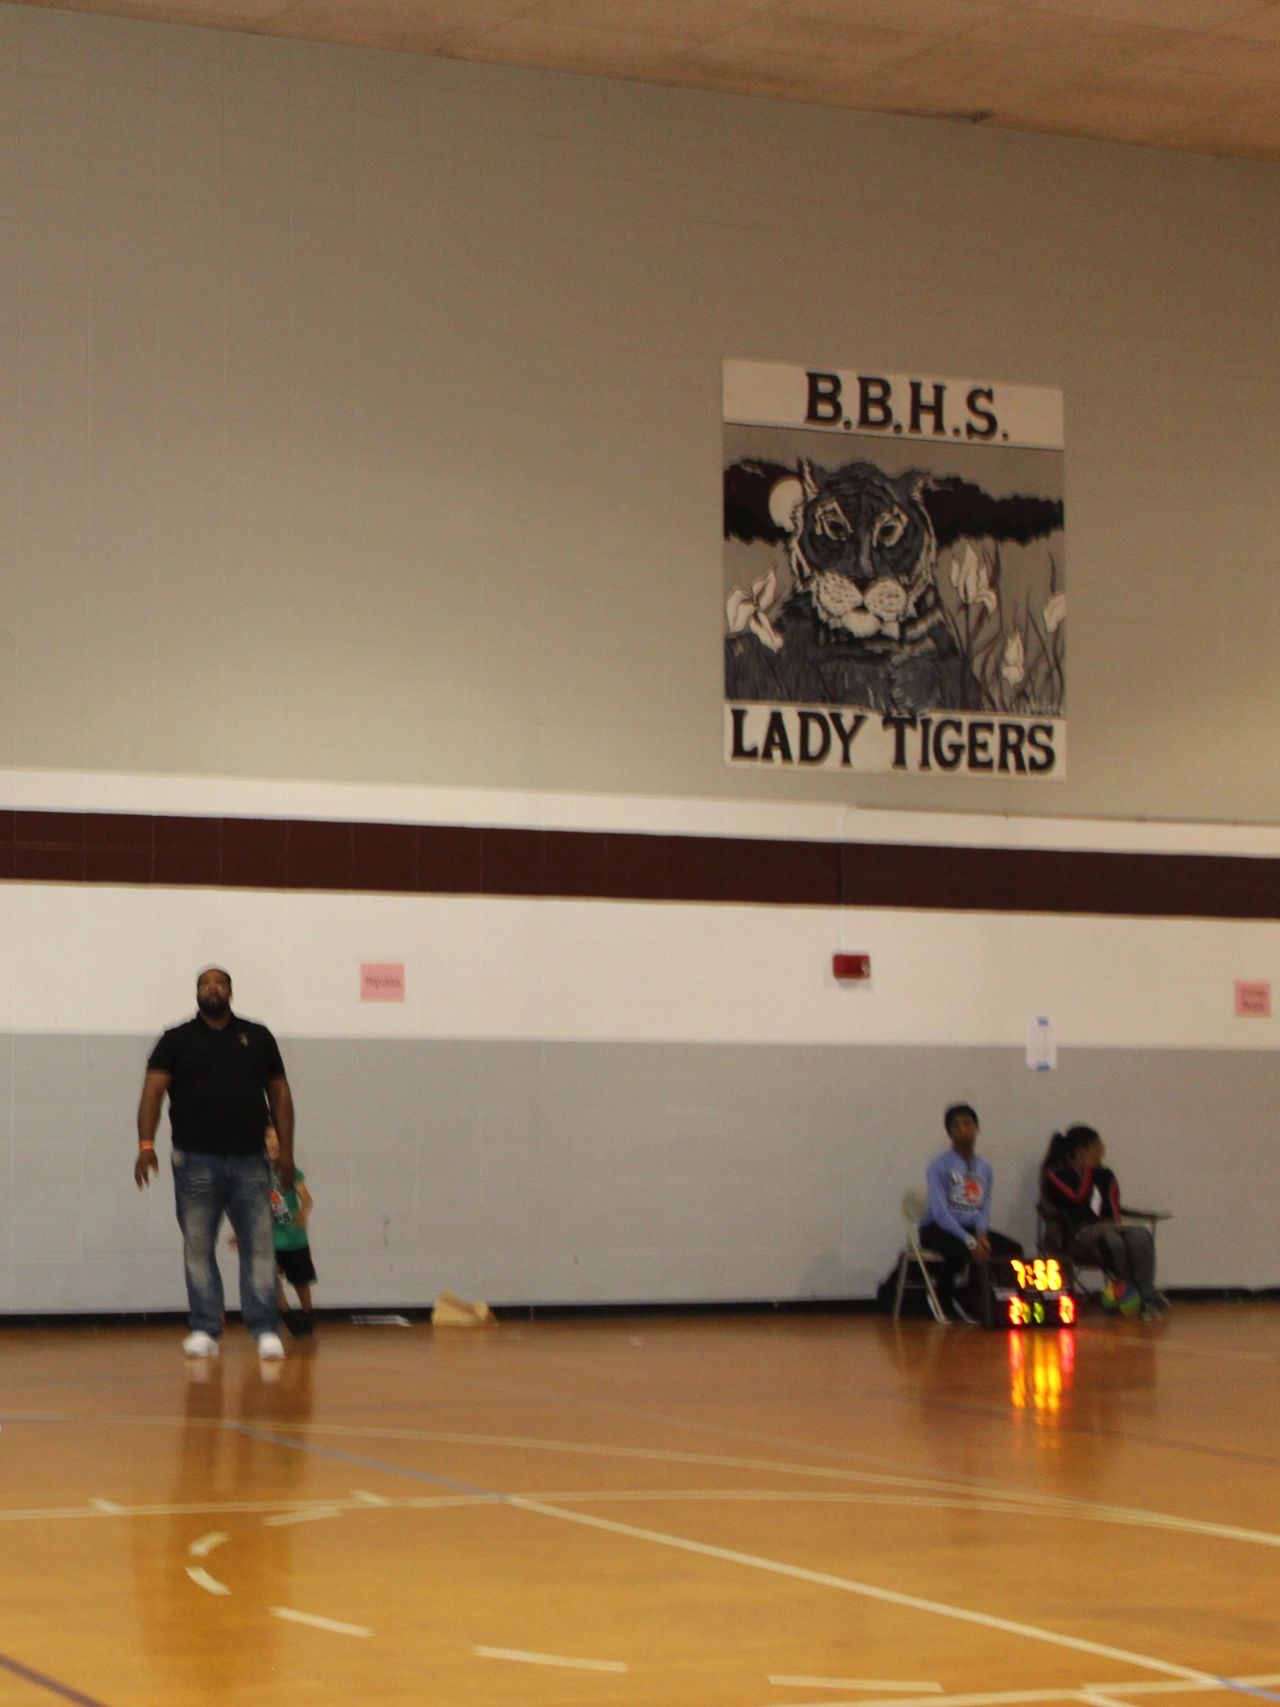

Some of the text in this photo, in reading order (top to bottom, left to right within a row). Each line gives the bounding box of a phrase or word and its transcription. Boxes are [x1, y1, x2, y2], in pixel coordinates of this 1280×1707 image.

[804, 371, 1010, 443] B.B.H.S.
[730, 708, 1057, 775] LADY TIGERS
